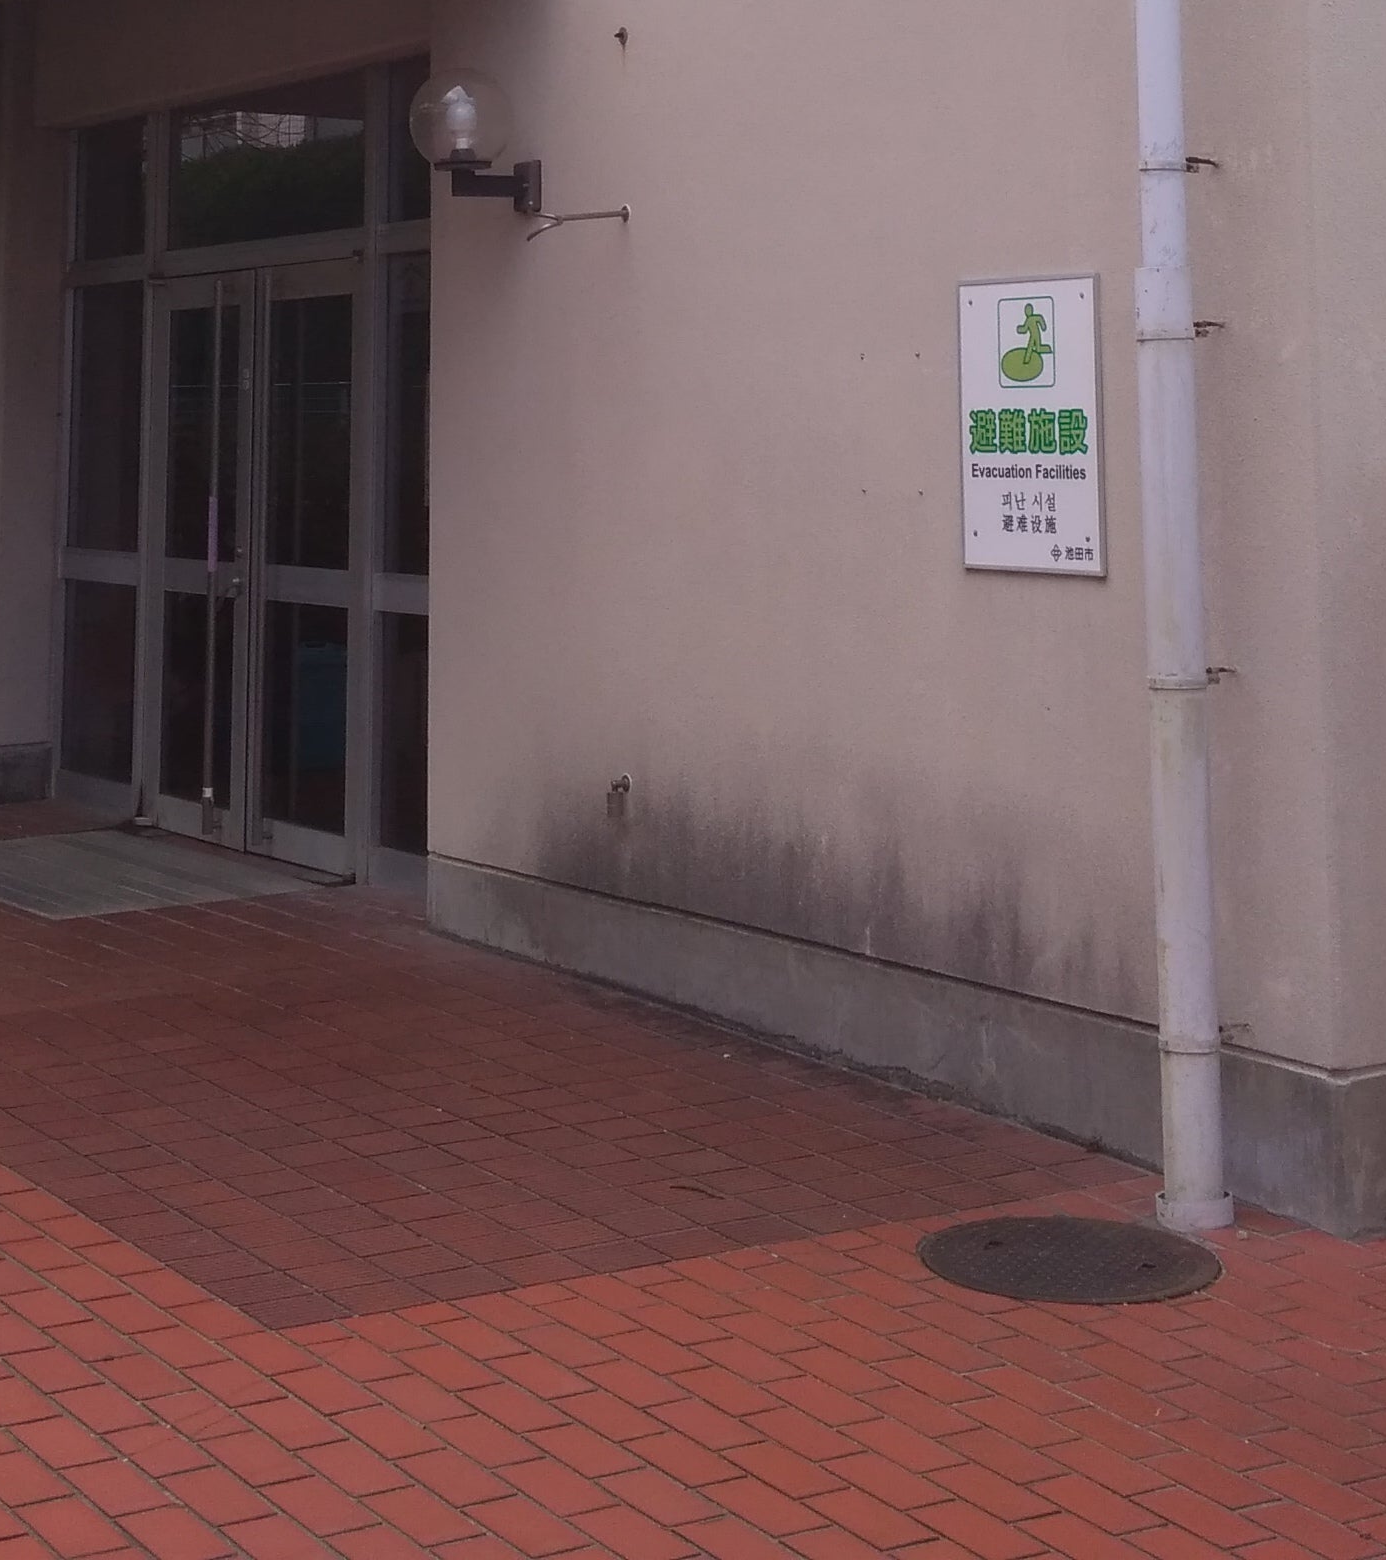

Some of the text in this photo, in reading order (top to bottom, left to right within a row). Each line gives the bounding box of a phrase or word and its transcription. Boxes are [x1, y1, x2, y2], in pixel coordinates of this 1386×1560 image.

[969, 409, 1088, 454] 避難施設
[971, 463, 1086, 480] Evacuation Facilities
[1001, 491, 1056, 512] 피난 시설
[1001, 514, 1057, 534] 避难设施
[1064, 545, 1094, 561] 池田市
